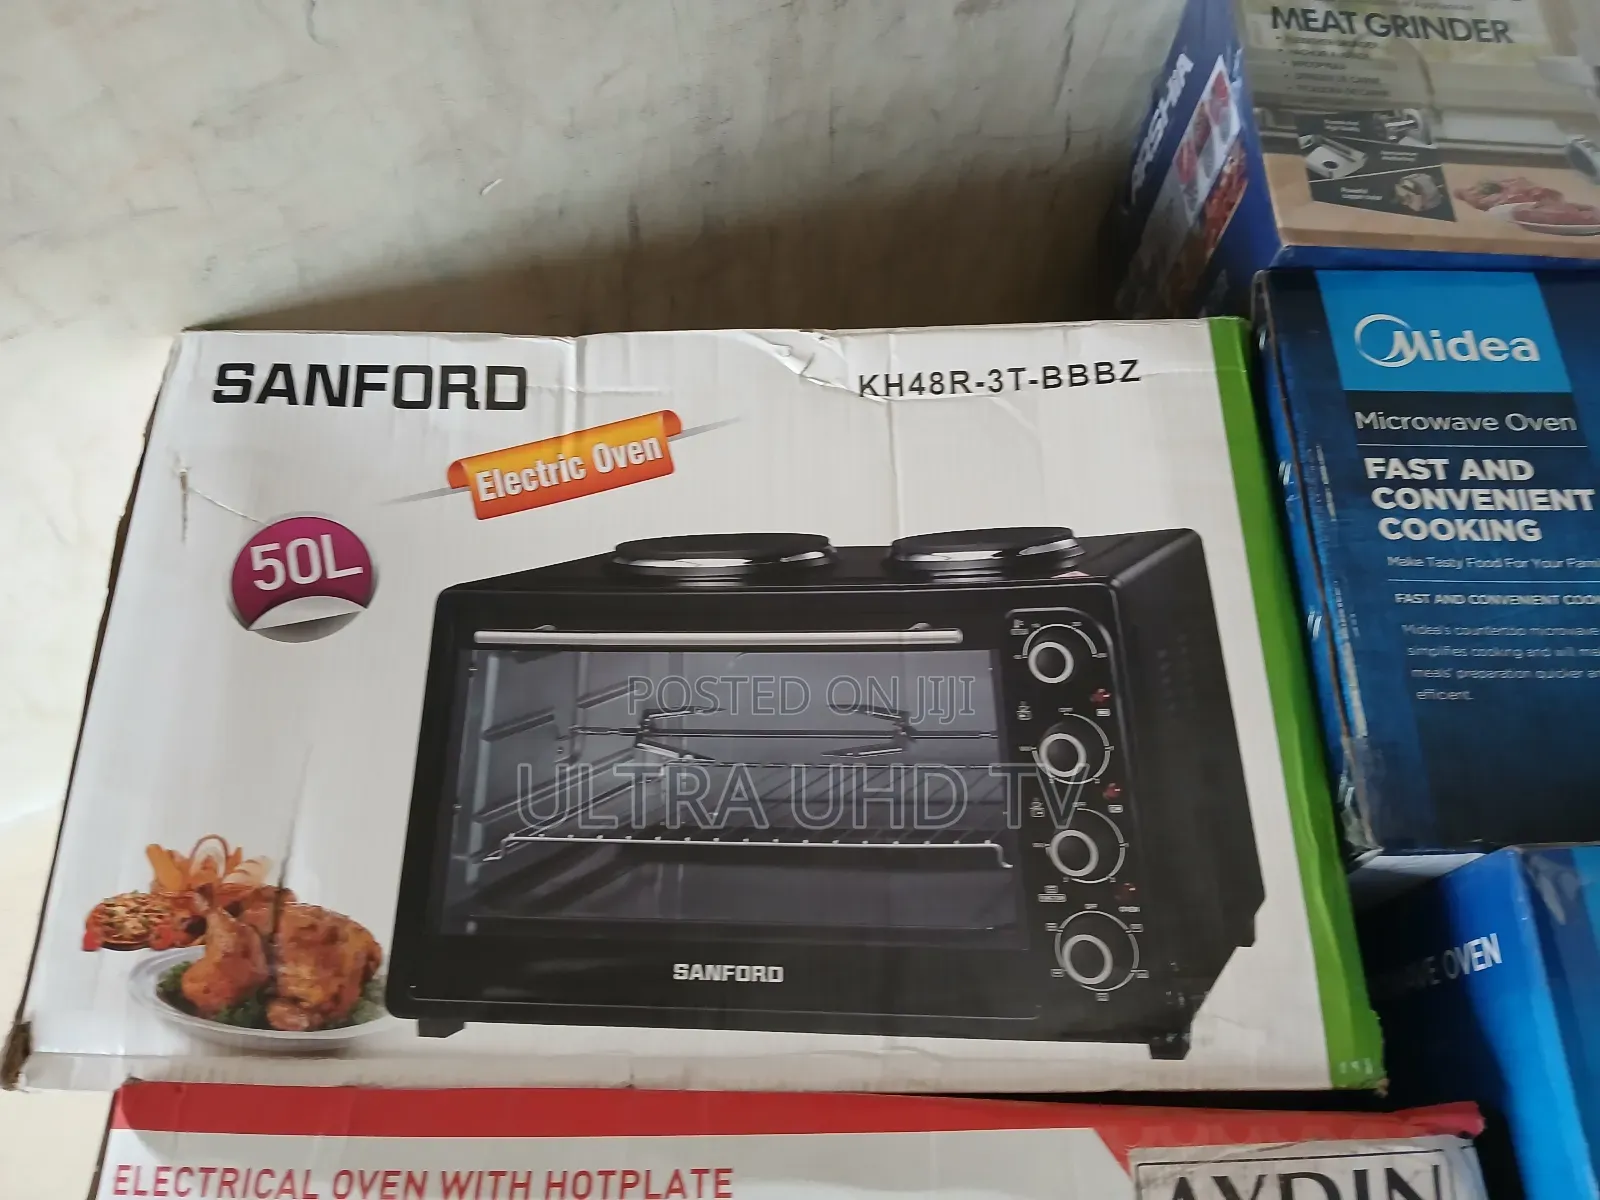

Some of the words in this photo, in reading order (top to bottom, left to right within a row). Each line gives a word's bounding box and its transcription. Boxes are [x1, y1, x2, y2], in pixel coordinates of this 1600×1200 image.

[1271, 6, 1358, 35] MEAT
[1363, 12, 1515, 44] GRINDER
[1354, 313, 1541, 368] Midea
[212, 362, 527, 411] SANFORD
[858, 358, 1141, 398] KH48R-3T-BBBZ
[1355, 411, 1500, 431] Microwave
[1504, 412, 1577, 432] Oven
[475, 452, 587, 502] Electric
[592, 436, 664, 474] Oven
[1364, 457, 1450, 480] FAST
[1460, 458, 1535, 481] AND
[1371, 486, 1595, 511] CONVENIENT
[1378, 517, 1543, 542] COOKING
[249, 532, 363, 592] 50L
[1387, 556, 1424, 567] Make
[1426, 556, 1463, 569] Tasty
[1465, 557, 1503, 568] Food
[1504, 557, 1529, 568] For
[1531, 558, 1563, 568] Your
[1394, 593, 1431, 604] FAST
[1433, 594, 1466, 605] AND
[1467, 594, 1560, 605] CONVENIENT
[1470, 648, 1523, 659] cooking
[1526, 648, 1553, 657] and
[1443, 933, 1503, 980] OVEN
[672, 963, 784, 983] SANFORD
[112, 1164, 320, 1200] ELECTRICAL
[332, 1169, 429, 1200] OVEN
[440, 1170, 533, 1200] WITH
[544, 1167, 734, 1200] HOTPLATE
